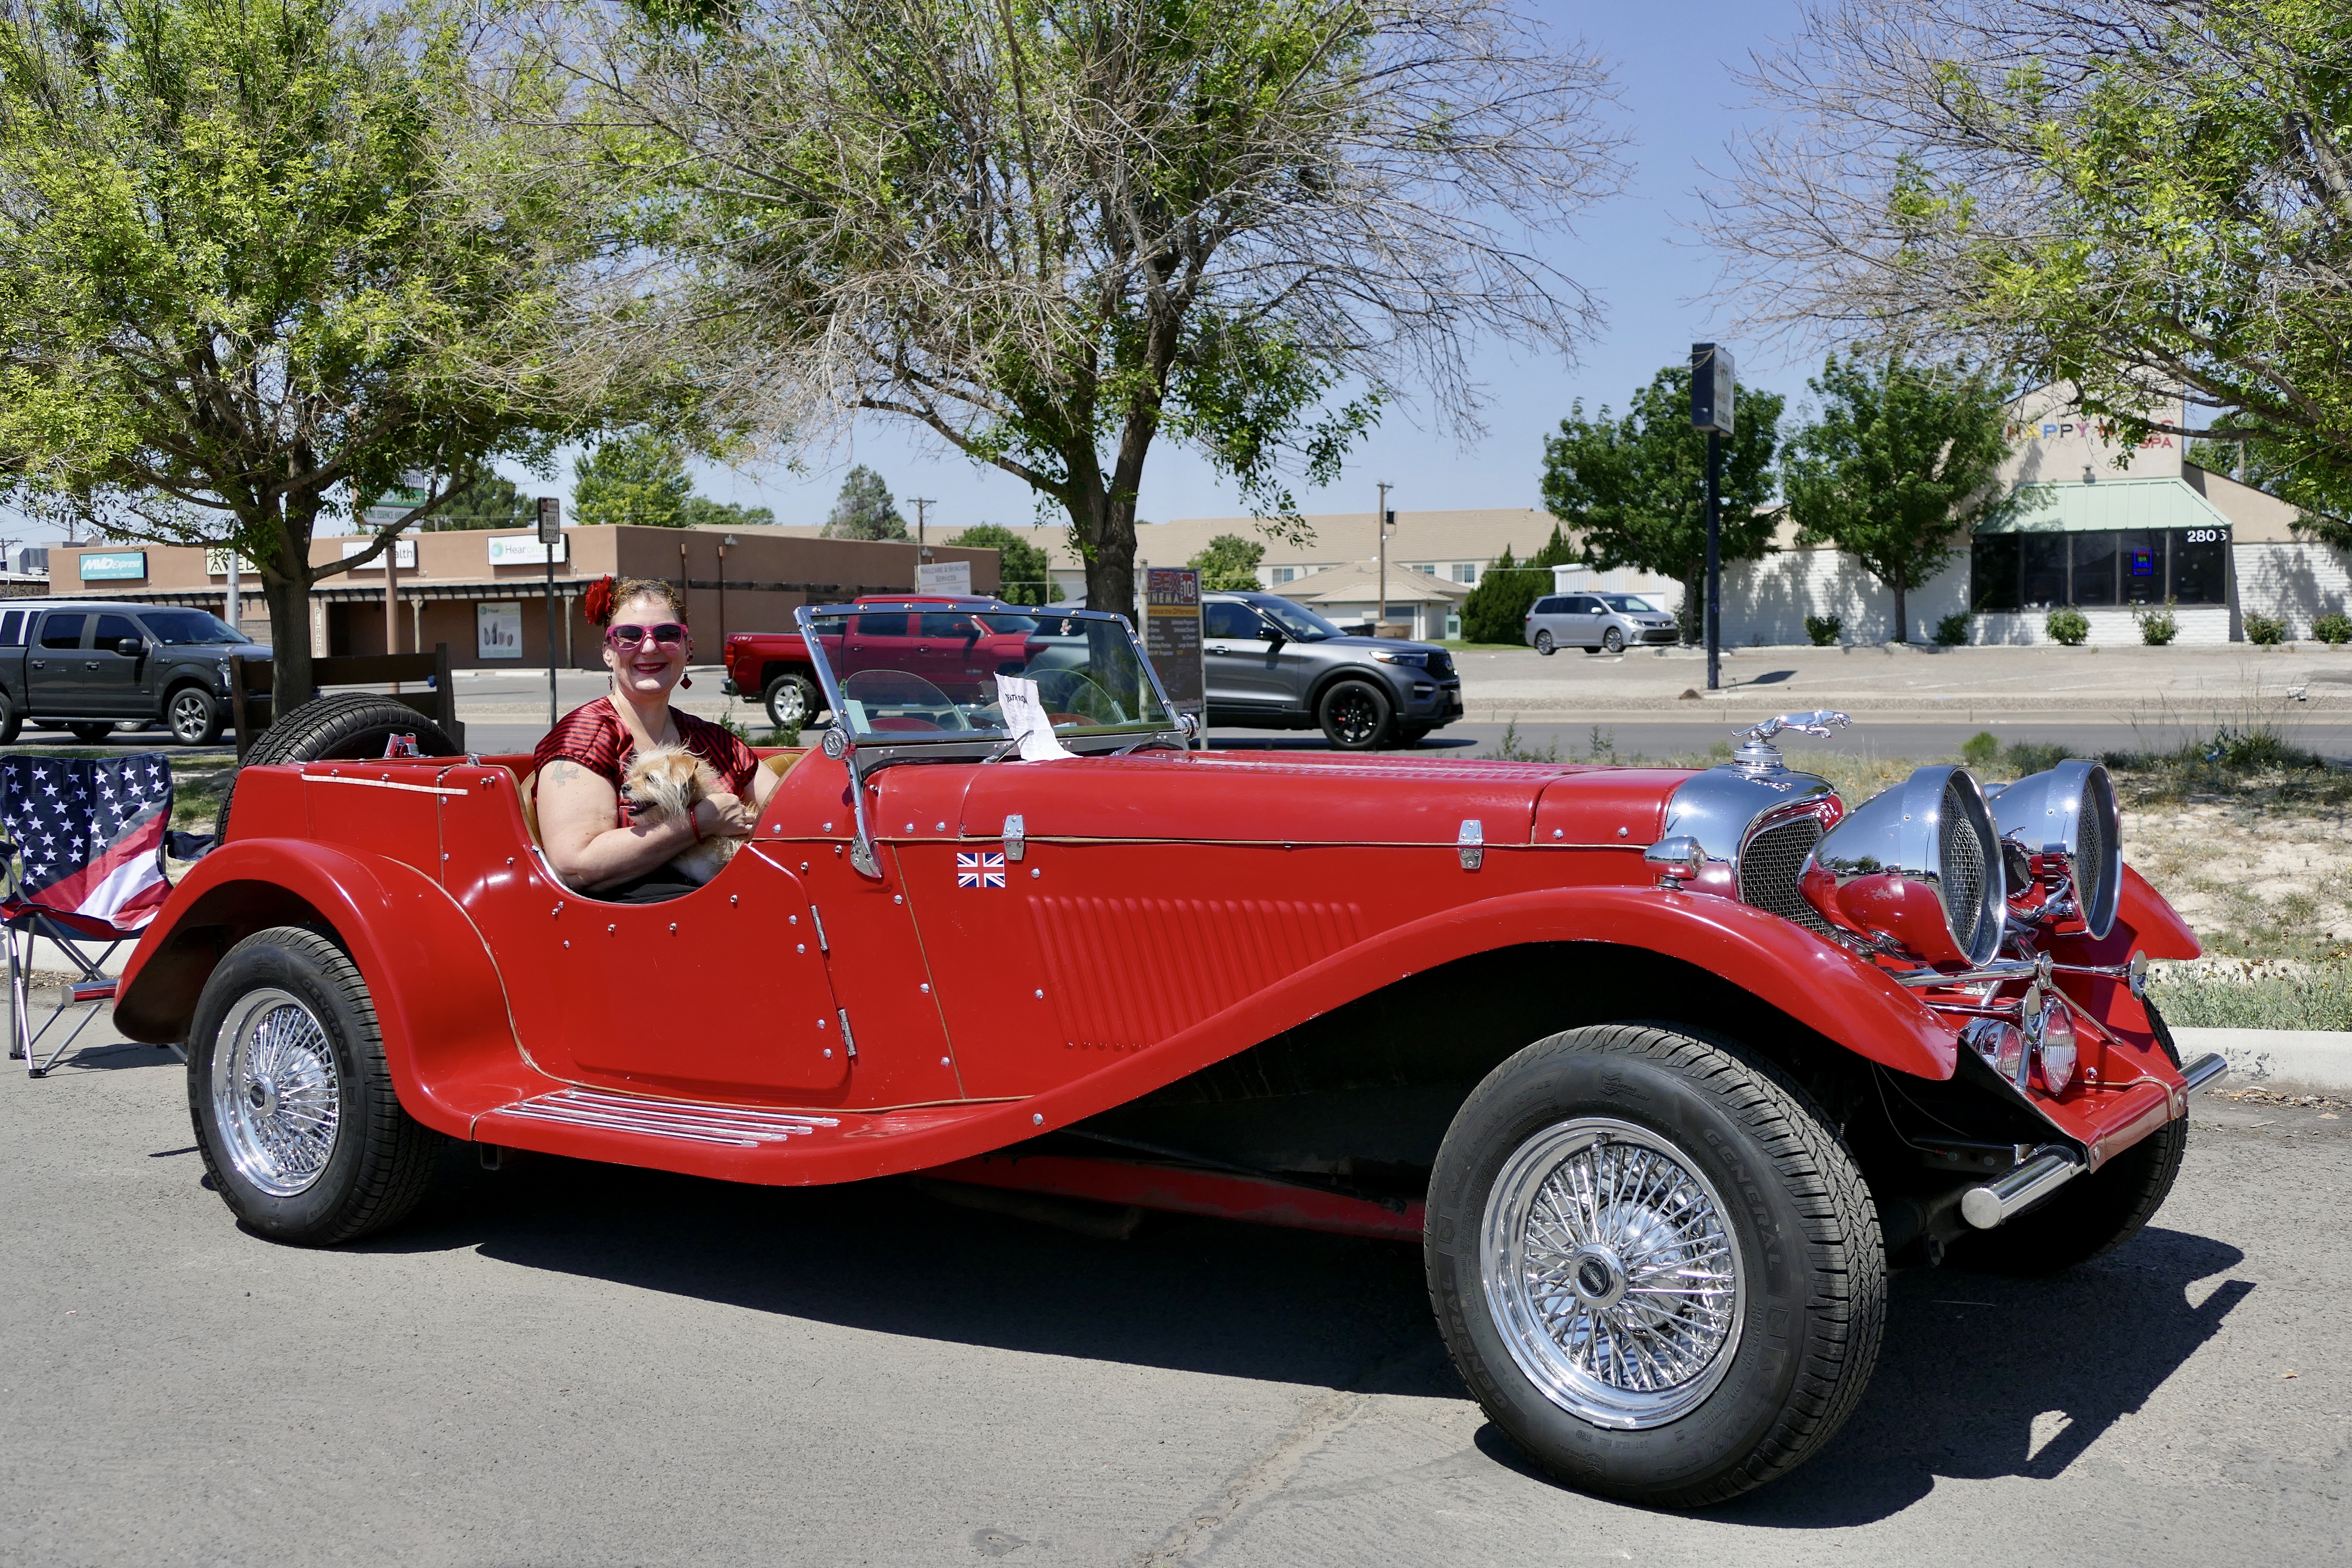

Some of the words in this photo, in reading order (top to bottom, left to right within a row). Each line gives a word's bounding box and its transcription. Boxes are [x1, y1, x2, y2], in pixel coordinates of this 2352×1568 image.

[2006, 423, 2090, 440] HAPPY
[2140, 437, 2174, 449] SPA
[395, 510, 407, 519] AVED
[546, 516, 556, 525] BUS
[545, 529, 558, 538] STOP
[381, 549, 413, 559] Halth
[505, 545, 526, 554] Hear
[82, 557, 114, 571] MVD
[112, 560, 141, 571] Express
[1182, 580, 1193, 598] 10
[1148, 592, 1180, 604] INEMA
[1701, 1121, 1782, 1271] GENERAL
[1441, 1275, 1509, 1411] GENERAL
[1704, 1357, 1779, 1455] ALTIMAX
